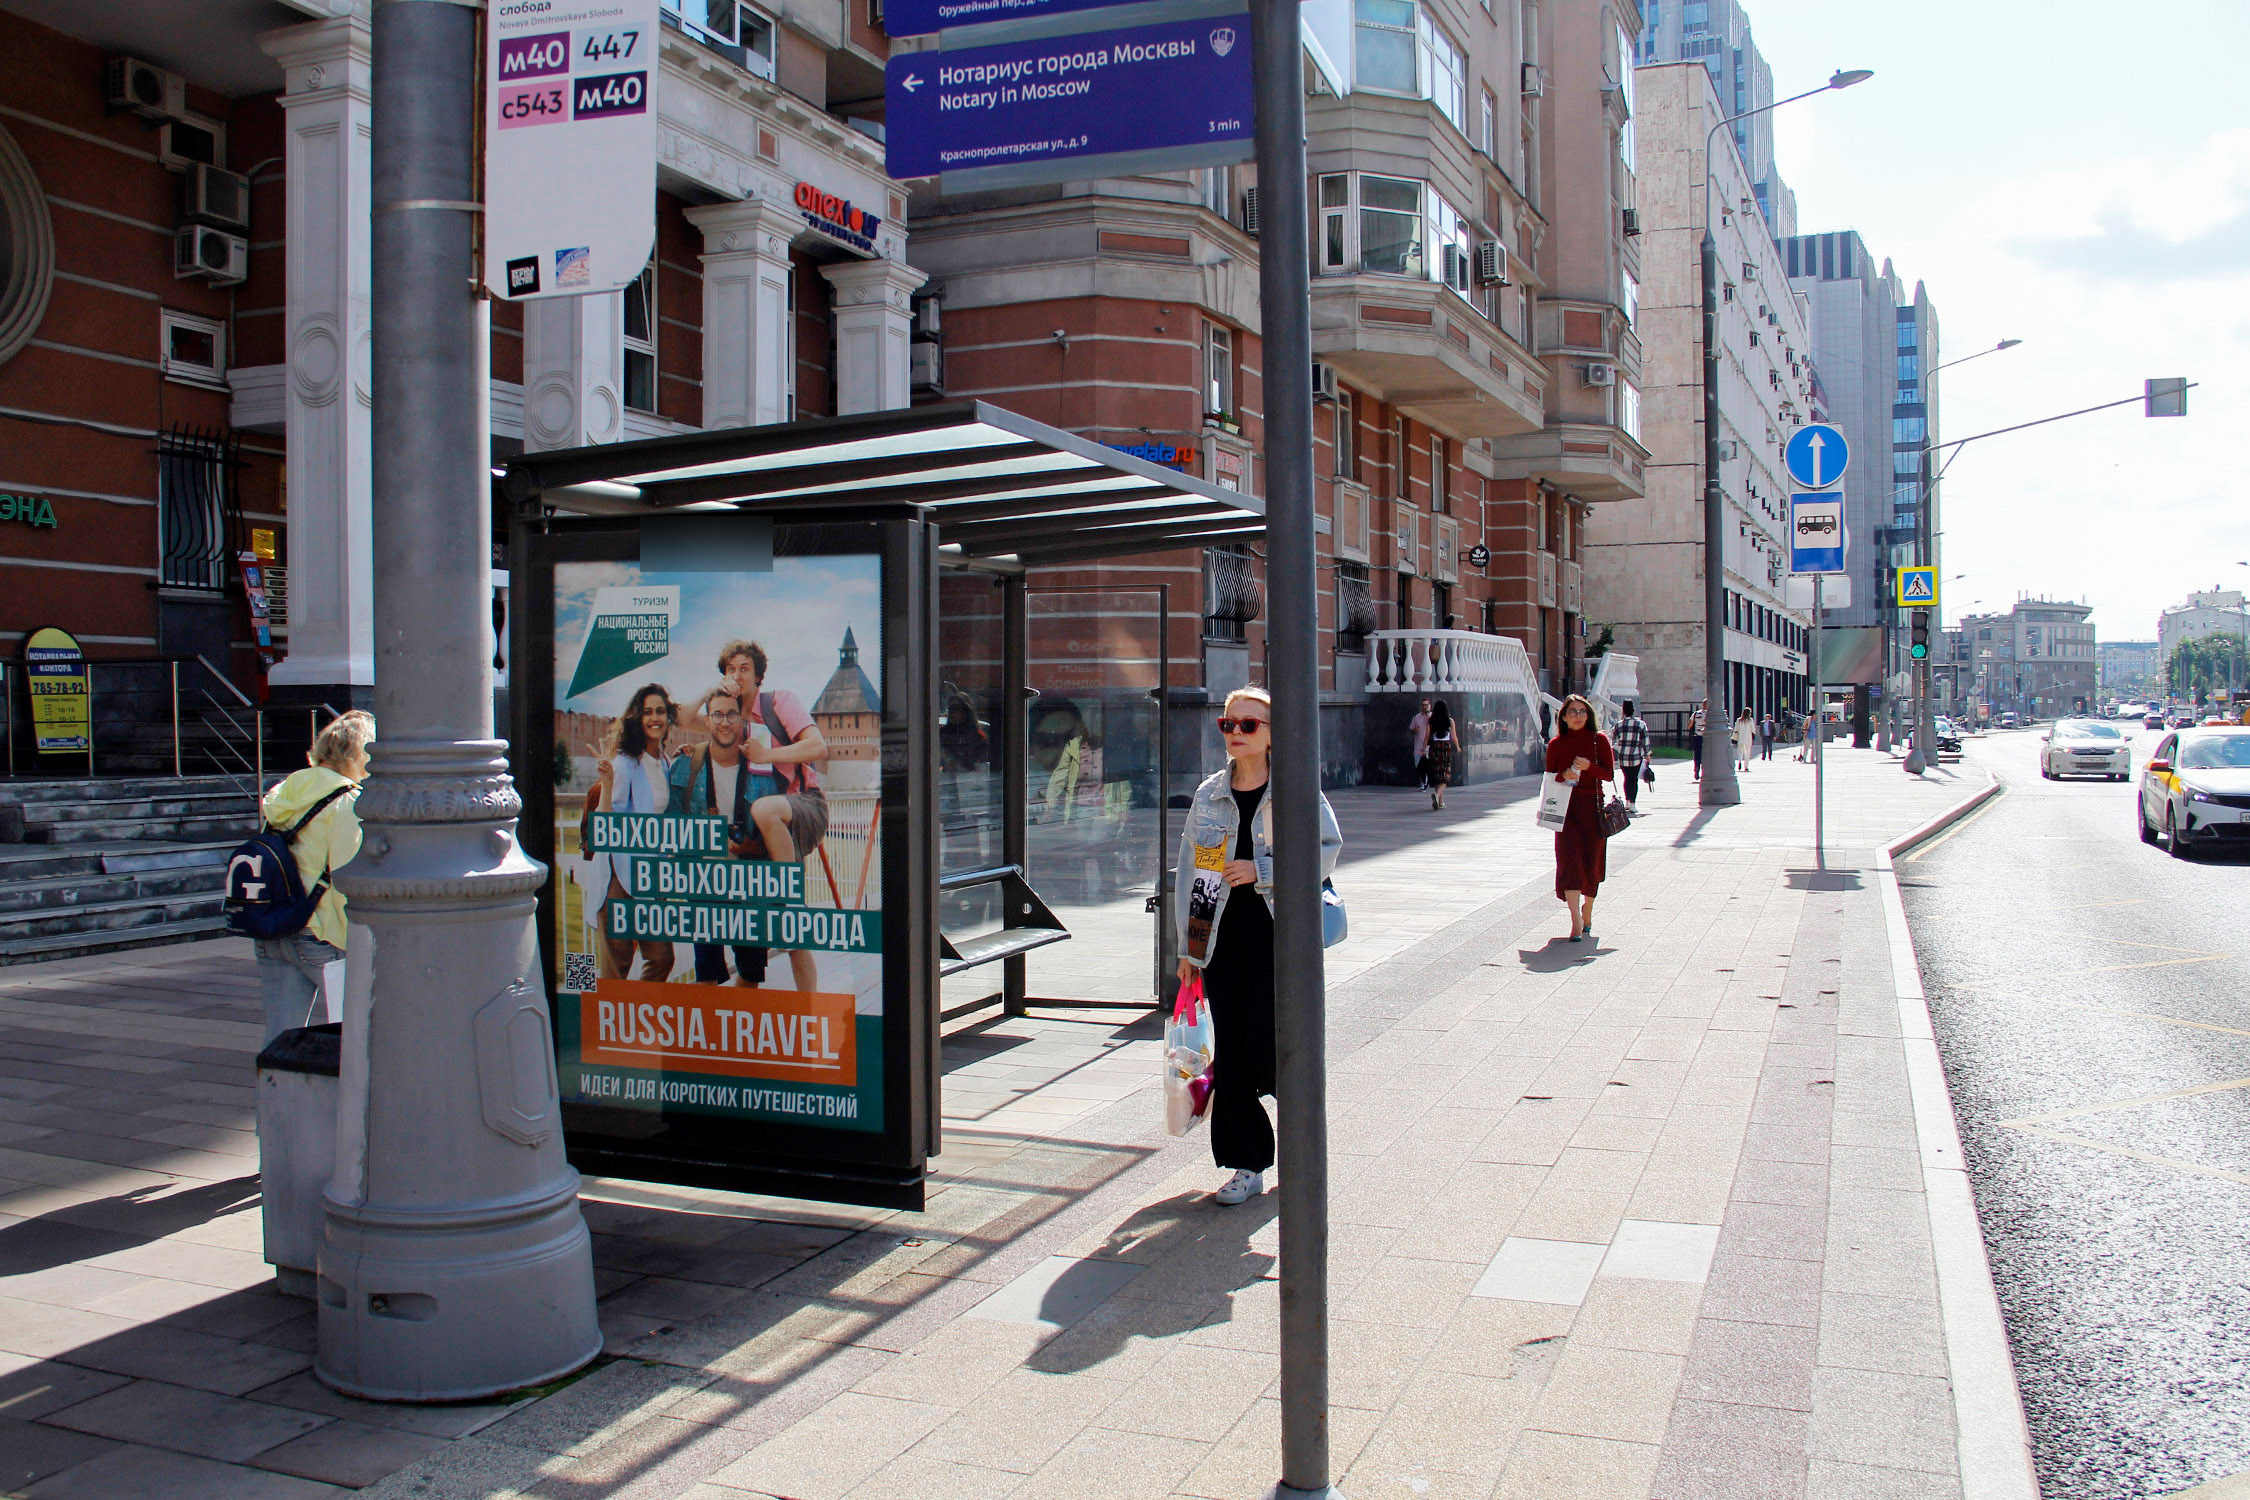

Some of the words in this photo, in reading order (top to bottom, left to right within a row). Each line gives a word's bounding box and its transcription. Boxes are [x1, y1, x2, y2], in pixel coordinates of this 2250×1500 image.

[499, 21, 529, 30] Novaya
[531, 11, 587, 26] Dmitrovskaya
[589, 8, 624, 18] Sloboda
[500, 1, 551, 16] слобода
[939, 0, 999, 18] Оружейный
[583, 31, 640, 62] 447
[939, 60, 1033, 86] Нотариус
[1038, 50, 1108, 74] города
[1113, 40, 1195, 64] Москвы
[502, 90, 563, 120] с543
[940, 87, 997, 111] Notary
[1001, 86, 1017, 103] in
[1022, 79, 1090, 101] Moscow
[1209, 121, 1215, 132] 3
[1218, 119, 1240, 131] min
[941, 139, 1048, 162] Краснопролетарская
[1069, 138, 1079, 149] д.
[1081, 136, 1088, 147] 9
[632, 597, 669, 606] ТУРИЗМ
[598, 615, 667, 629] НАЦИОНАЛЬНЫЕ
[627, 628, 667, 641] ПРОЕКТЫ
[633, 641, 668, 654] РОССИИ
[39, 664, 72, 673] КОНТОРА
[33, 682, 84, 694] 785-78-92
[593, 815, 722, 853] ВЫХОДИТЕ
[637, 861, 650, 892] В
[658, 861, 801, 900] ВЫХОДНЫЕ
[613, 902, 627, 933] В
[634, 903, 759, 942] СОСЕДНИЕ
[767, 910, 866, 950] ГОРОДА
[598, 1000, 839, 1060] RUSSIA.TRAVEL
[580, 1073, 620, 1097] ИДЕИ
[624, 1078, 656, 1101] ДЛЯ
[660, 1081, 737, 1108] КОРОТКИХ
[742, 1093, 857, 1119] ПУТЕШЕСТВИЙ
